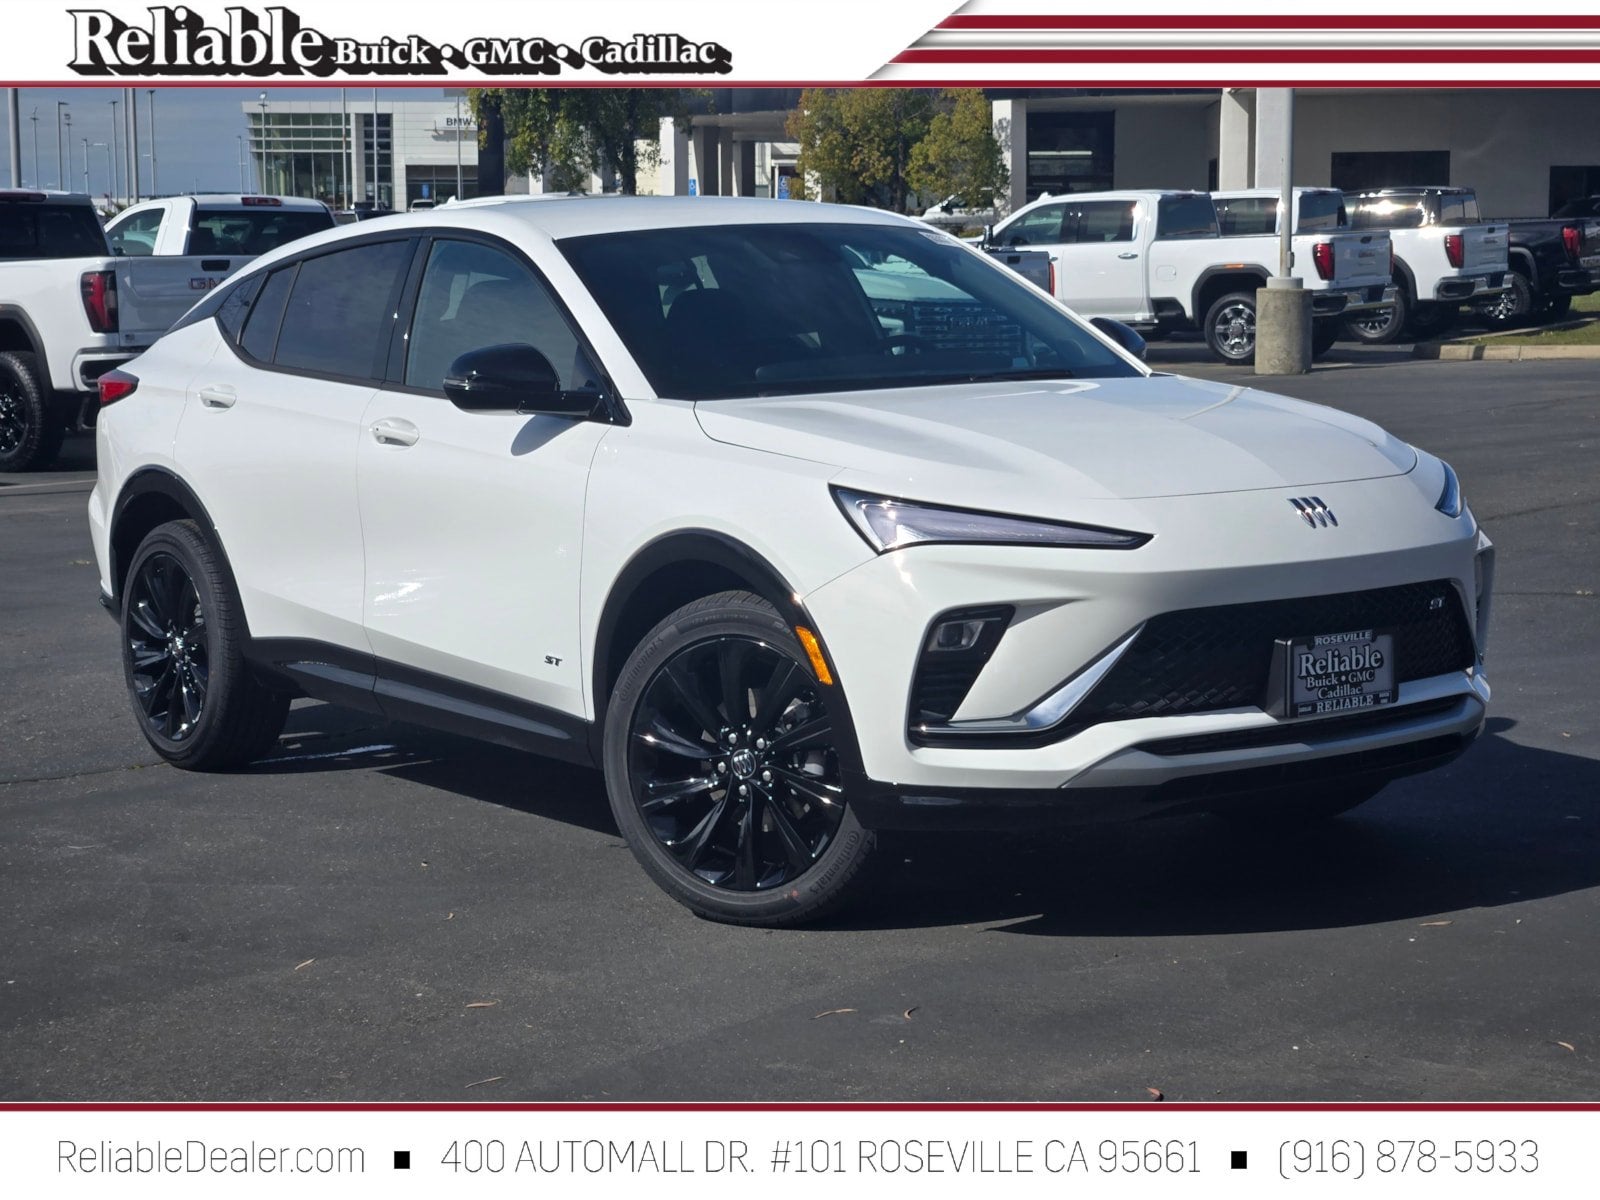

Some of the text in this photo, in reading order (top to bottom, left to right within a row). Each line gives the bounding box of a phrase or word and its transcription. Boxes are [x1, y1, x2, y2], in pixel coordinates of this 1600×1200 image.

[446, 117, 472, 126] BMW
[1315, 631, 1372, 646] ROSEVILLE
[544, 655, 563, 667] ST
[1299, 645, 1383, 677] Reliable
[1306, 669, 1375, 689] Buick GMC
[1317, 685, 1362, 700] Cadillac
[1316, 694, 1374, 713] RELIABLE
